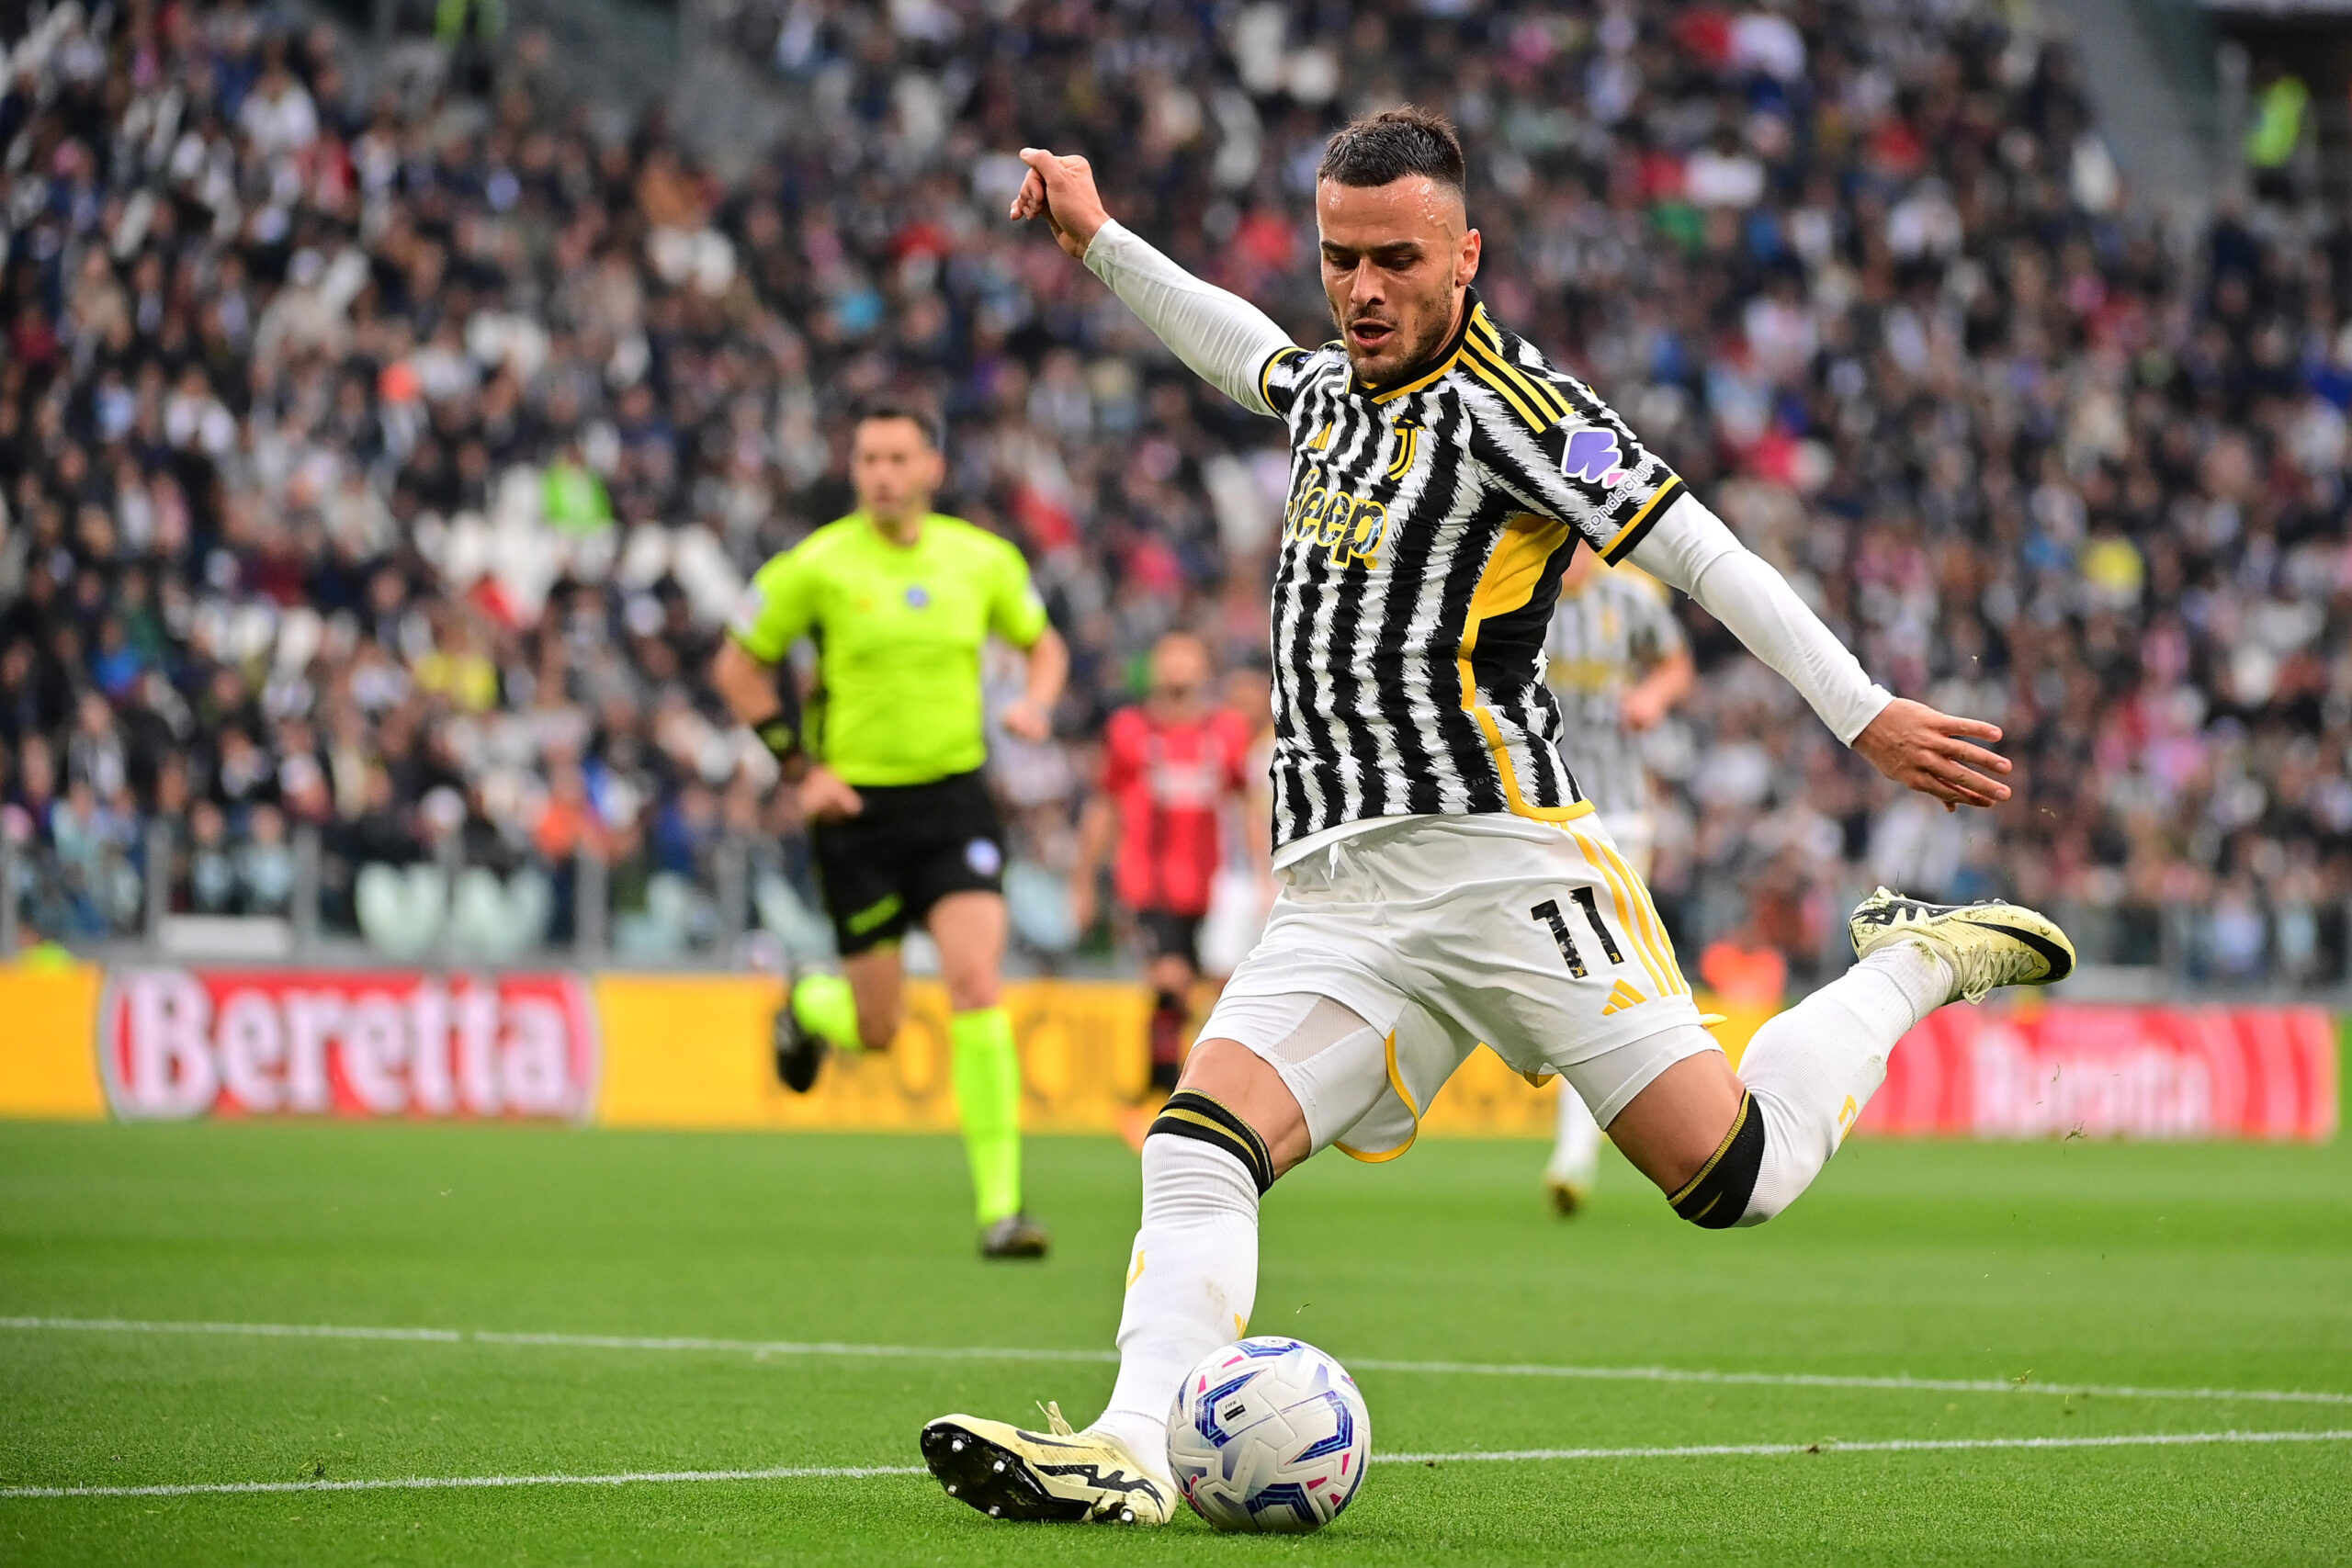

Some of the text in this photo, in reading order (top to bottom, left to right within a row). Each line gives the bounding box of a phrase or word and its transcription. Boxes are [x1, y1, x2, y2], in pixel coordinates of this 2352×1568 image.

[1283, 468, 1387, 568] Jeep
[1582, 456, 1657, 534] zondacryp
[1530, 886, 1625, 979] 11
[127, 967, 571, 1118] Beretta
